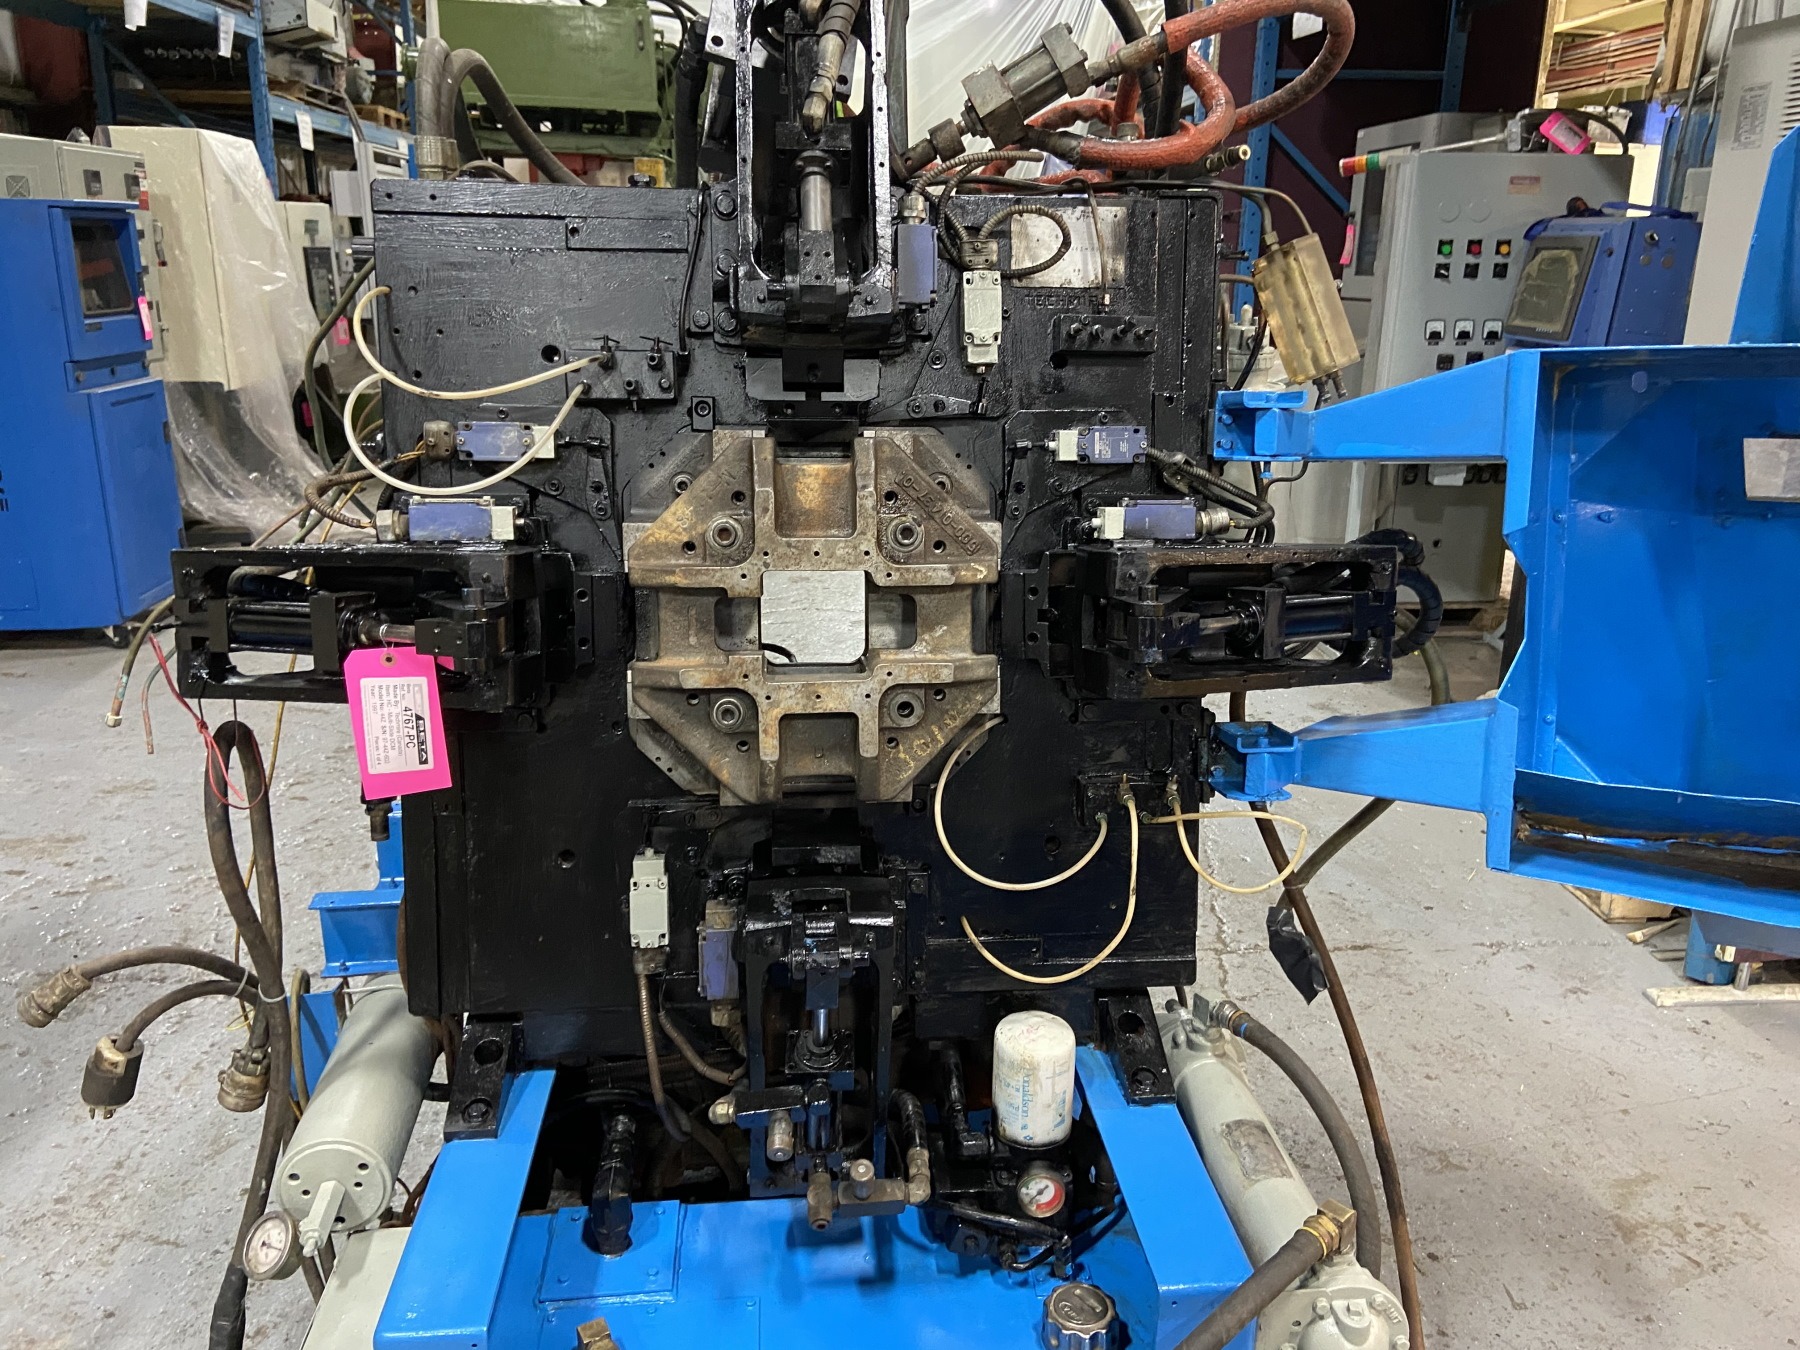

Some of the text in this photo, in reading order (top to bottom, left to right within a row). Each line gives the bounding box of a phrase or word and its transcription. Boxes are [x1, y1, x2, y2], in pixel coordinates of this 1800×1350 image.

[1025, 294, 1104, 310] TECHMIR
[386, 699, 392, 708] HC
[403, 706, 416, 749] 4767-PC
[417, 720, 427, 761] BETA
[396, 735, 404, 756] (Canada)
[1021, 1068, 1034, 1117] Donaldson
